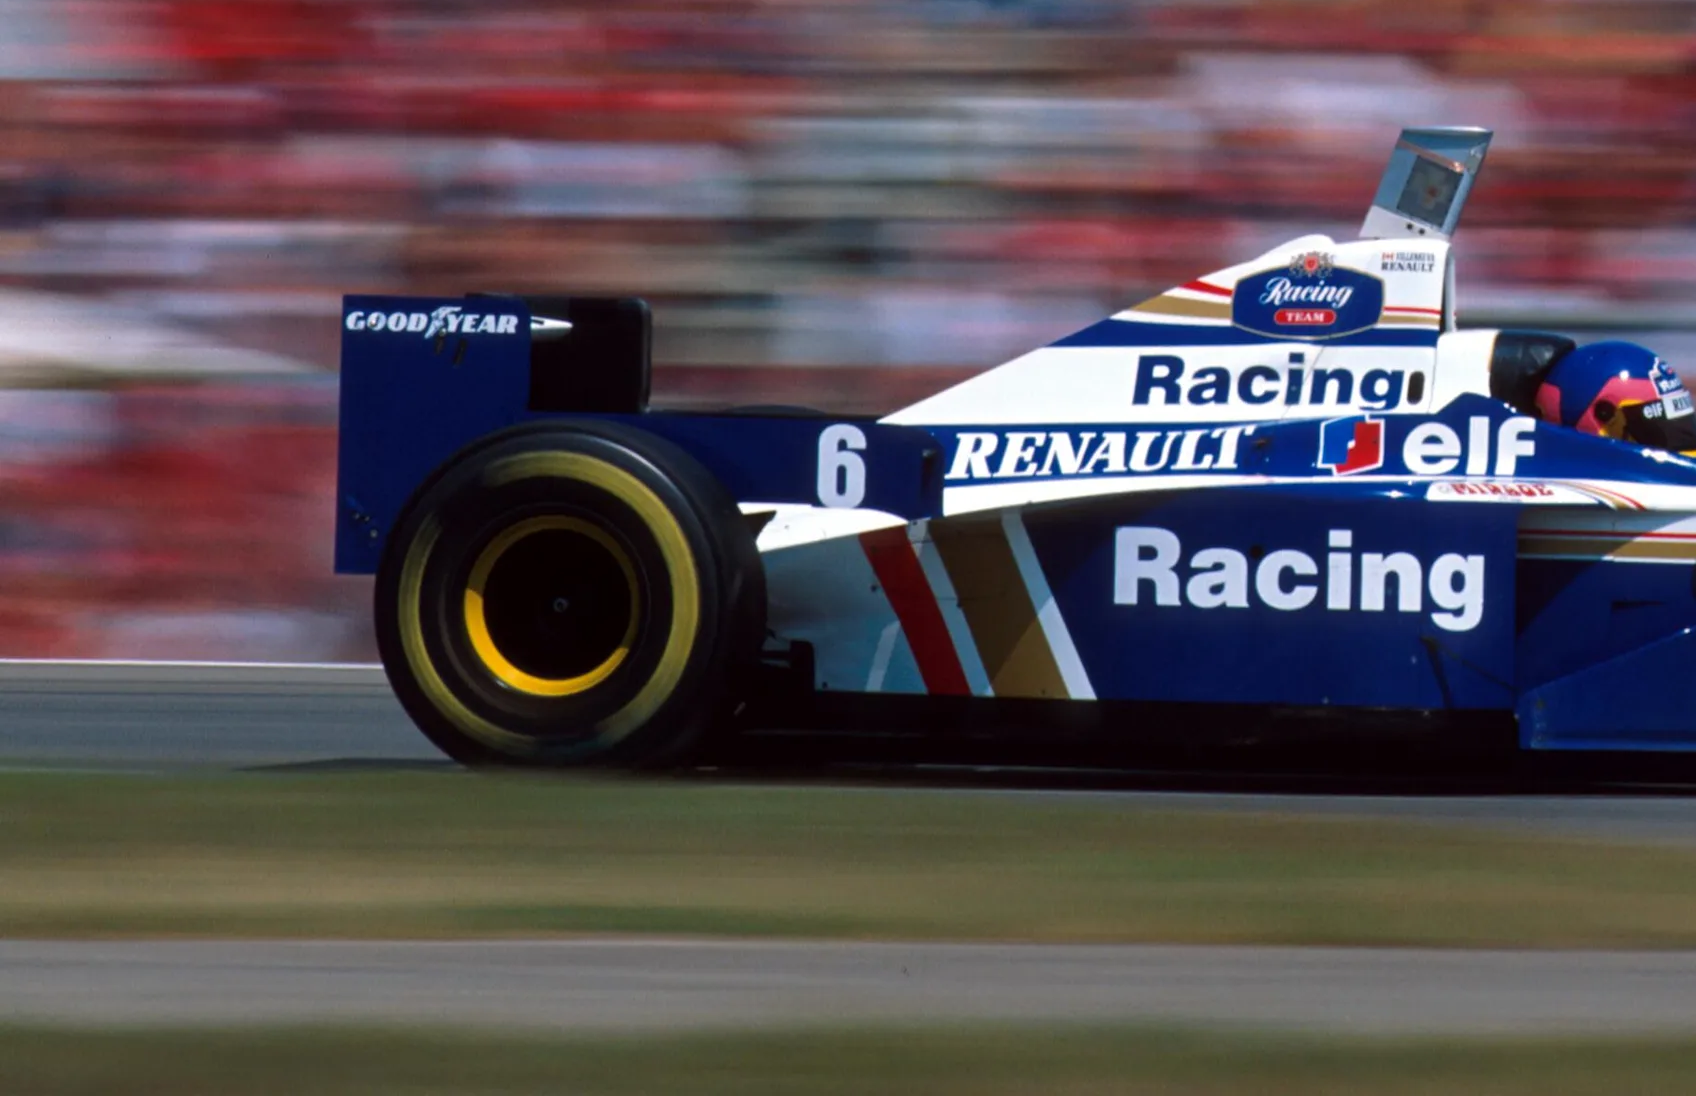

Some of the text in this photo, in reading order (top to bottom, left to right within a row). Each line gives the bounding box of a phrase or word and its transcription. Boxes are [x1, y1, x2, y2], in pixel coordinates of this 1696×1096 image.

[1380, 262, 1435, 273] RENAULT
[1259, 276, 1354, 309] Racing
[345, 306, 519, 339] GOODYEAR
[1285, 311, 1325, 323] TEAM
[1132, 352, 1405, 412] Racing
[1643, 402, 1663, 420] elf
[817, 424, 868, 509] 6
[944, 424, 1257, 480] RENAULT
[1402, 416, 1536, 476] elf
[1113, 526, 1486, 632] Racing
